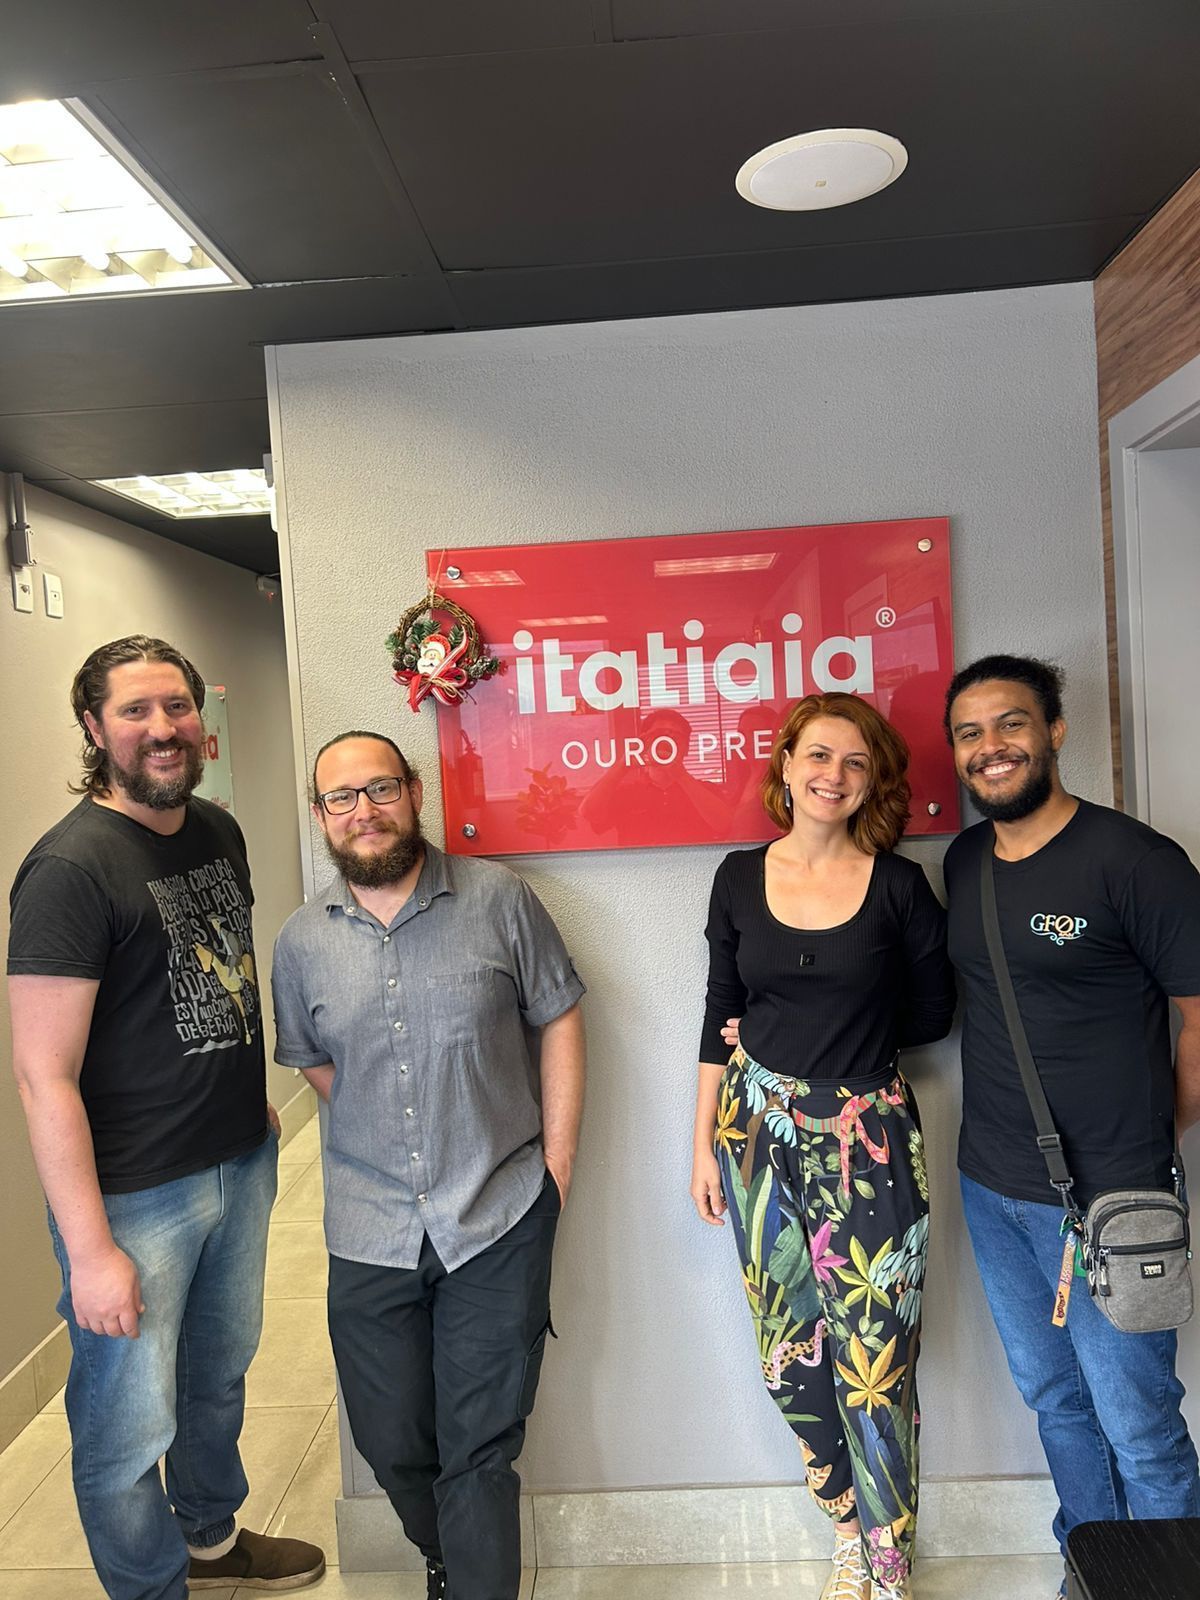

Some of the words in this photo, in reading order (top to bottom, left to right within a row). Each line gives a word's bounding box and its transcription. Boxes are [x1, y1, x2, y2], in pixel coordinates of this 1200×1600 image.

[513, 613, 874, 714] itatiaia
[561, 734, 678, 770] OURO
[697, 729, 783, 763] PRE
[188, 858, 236, 892] CORDURA
[210, 879, 246, 913] PEOR
[174, 1002, 190, 1021] ES
[188, 1001, 200, 1027] Y
[199, 1004, 213, 1020] NO
[175, 1013, 239, 1043] DEBERÍA
